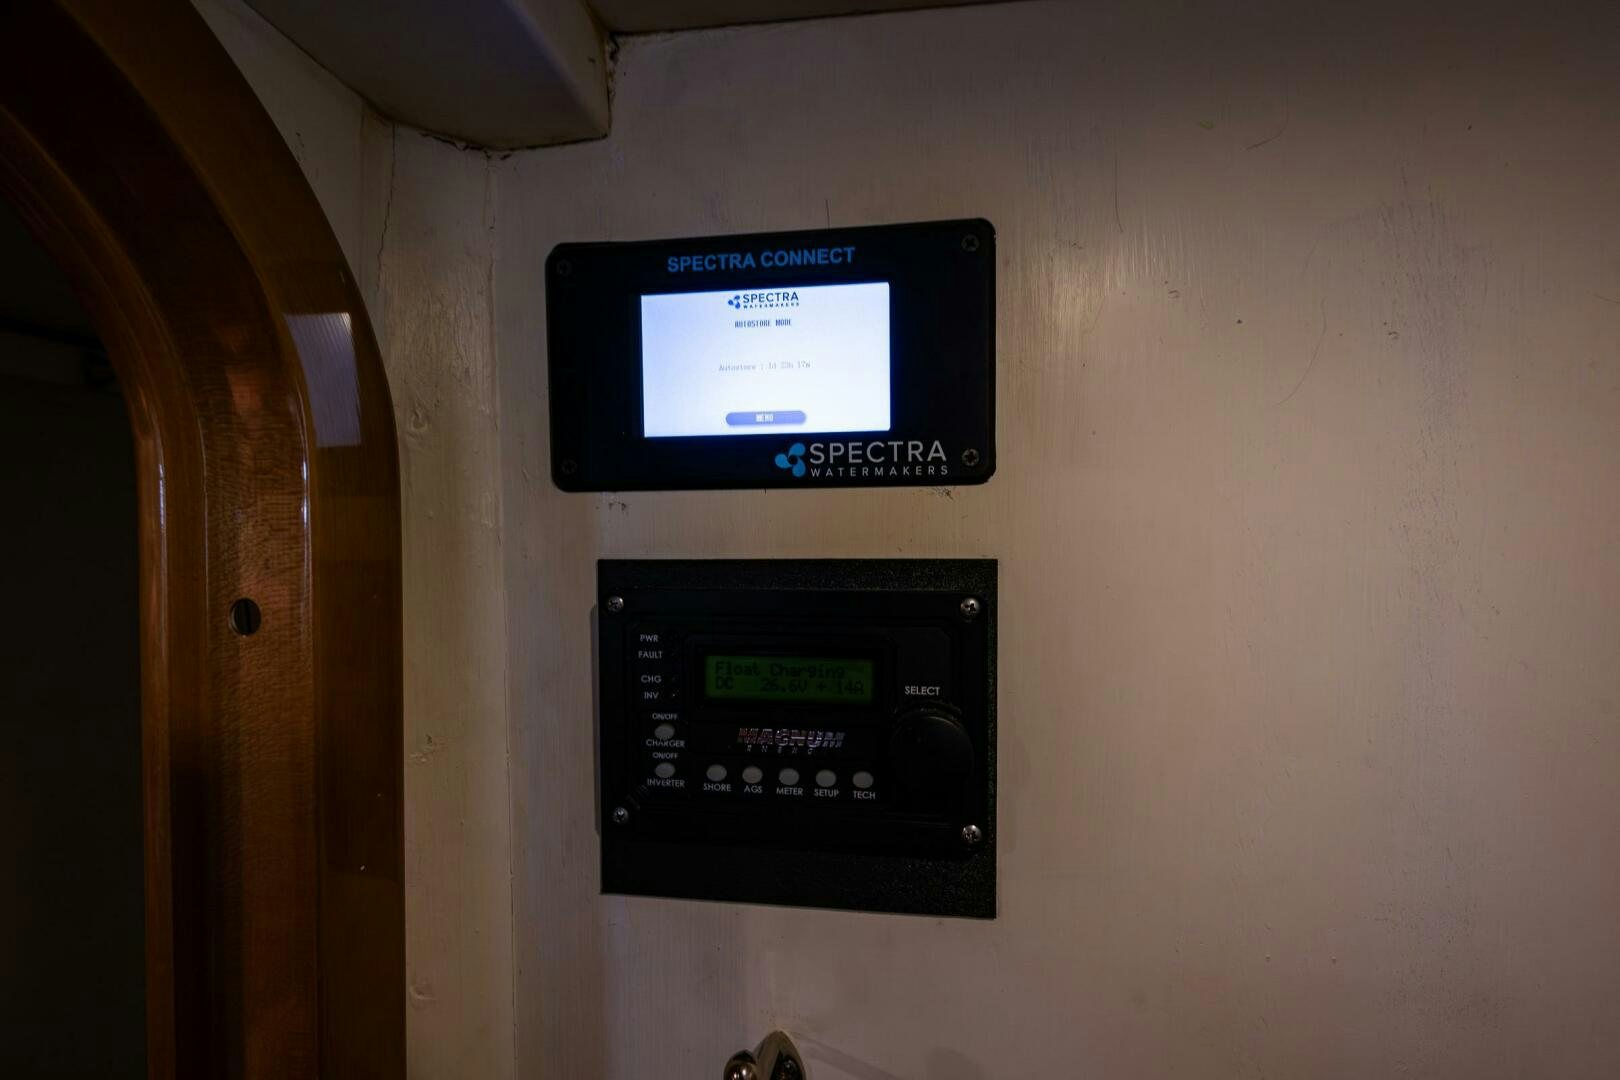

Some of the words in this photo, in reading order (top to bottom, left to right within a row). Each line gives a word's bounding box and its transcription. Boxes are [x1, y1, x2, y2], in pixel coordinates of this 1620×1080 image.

[667, 252, 756, 272] SPECTRA
[761, 247, 856, 267] CONNECT
[743, 291, 799, 304] SPECTRA
[776, 318, 791, 327] MODE
[809, 440, 947, 464] SPECTRA
[810, 465, 949, 478] WATERMAKERS
[640, 634, 659, 643] PWR
[638, 650, 663, 659] FAULT
[715, 661, 760, 677] Float
[769, 662, 846, 680] Charging
[640, 674, 662, 683] CHG
[715, 676, 735, 690] DC
[643, 691, 660, 699] INV
[904, 685, 942, 696] SELECT
[651, 712, 679, 721] ON/OFF
[645, 738, 686, 748] CHARGER
[737, 728, 847, 748] MAGNUM
[652, 751, 679, 760] ON/OFF
[647, 778, 686, 788] INVERTER
[703, 783, 732, 793] SHORE
[744, 785, 763, 794] AGS
[776, 787, 804, 796] METER
[814, 788, 840, 798] SETUP
[853, 790, 876, 800] TECH
